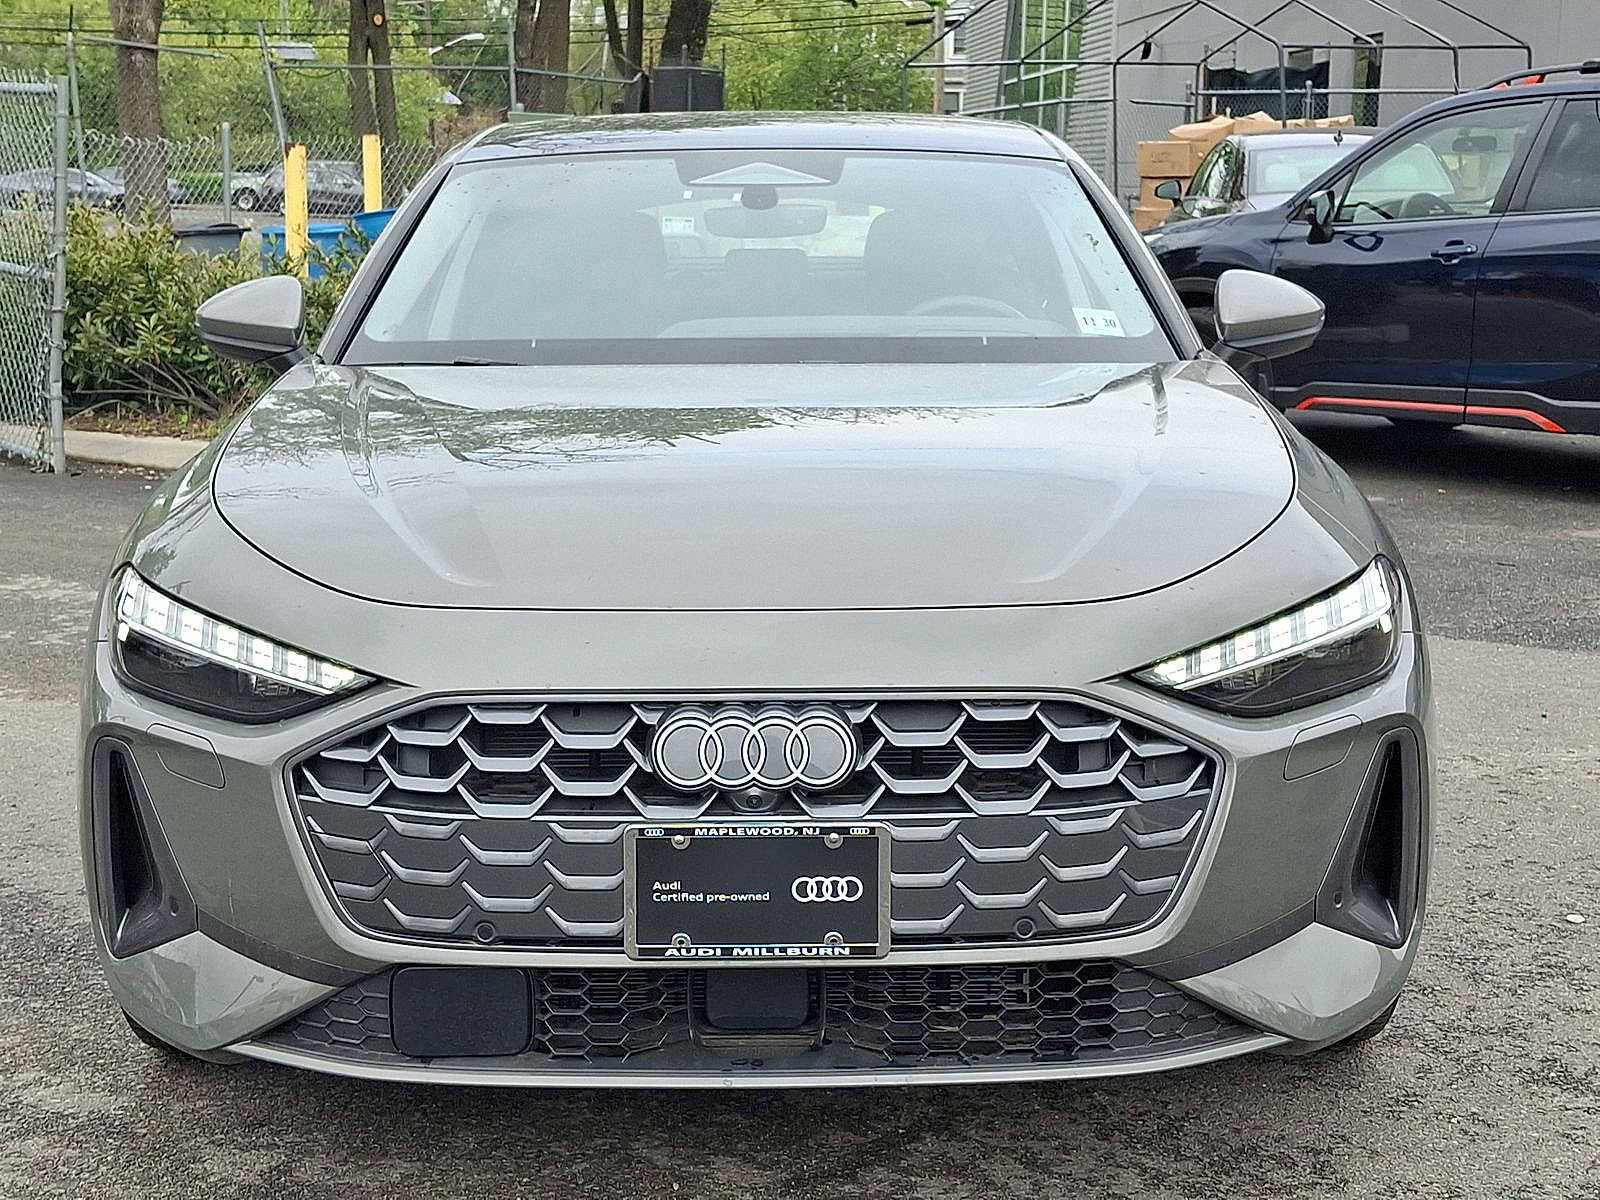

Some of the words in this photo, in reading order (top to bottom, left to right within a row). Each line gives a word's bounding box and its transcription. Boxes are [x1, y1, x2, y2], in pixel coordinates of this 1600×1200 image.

[694, 827, 799, 836] MAPLEWOOD,
[802, 827, 820, 836] NJ
[652, 881, 681, 890] Audi
[652, 892, 704, 902] Certified
[706, 892, 770, 903] pre-owned
[664, 948, 721, 956] AUDI
[733, 947, 850, 956] MILLBURN
